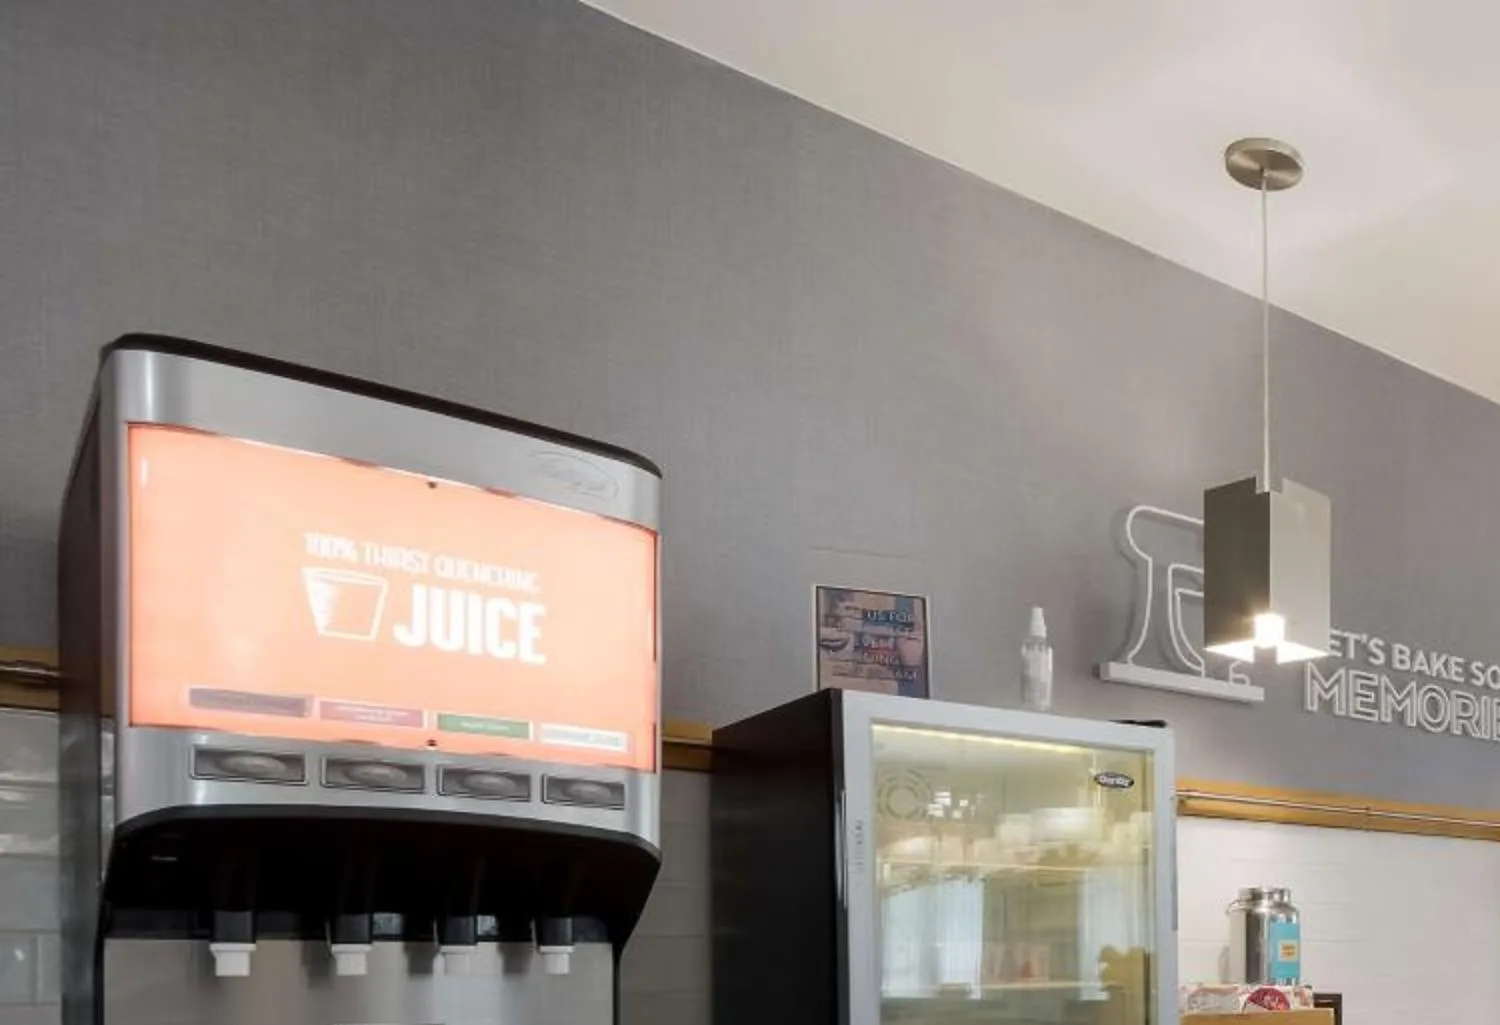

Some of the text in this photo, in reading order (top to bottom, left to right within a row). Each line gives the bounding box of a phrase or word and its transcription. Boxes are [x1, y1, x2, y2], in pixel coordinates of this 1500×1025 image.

[363, 541, 430, 574] THIRST
[392, 582, 546, 665] JUICE
[1330, 628, 1386, 666] ET'S
[1391, 643, 1466, 683] BAKE
